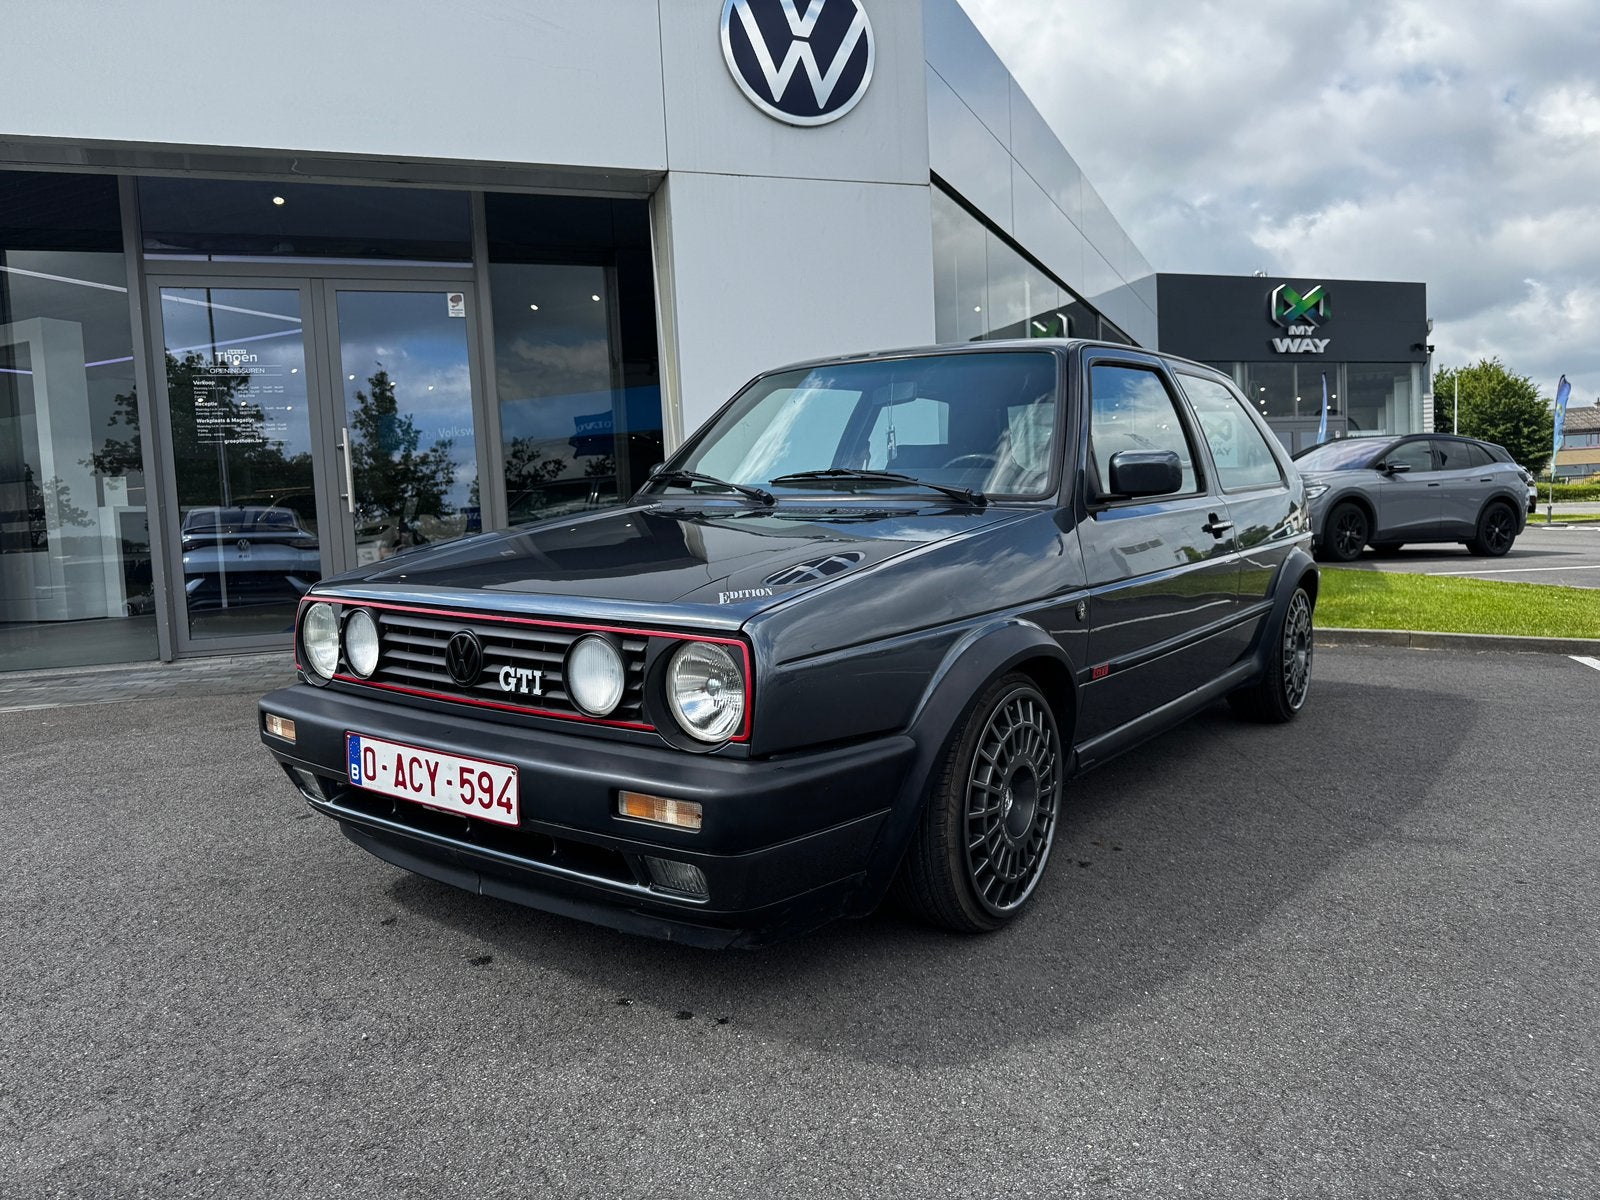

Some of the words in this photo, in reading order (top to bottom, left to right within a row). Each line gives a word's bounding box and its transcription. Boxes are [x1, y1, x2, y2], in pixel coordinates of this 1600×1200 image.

[722, 0, 876, 127] VW
[1287, 325, 1315, 336] MY
[1272, 338, 1331, 353] WAY
[215, 352, 258, 363] Thoen
[499, 665, 543, 696] GTI
[351, 763, 360, 780] B
